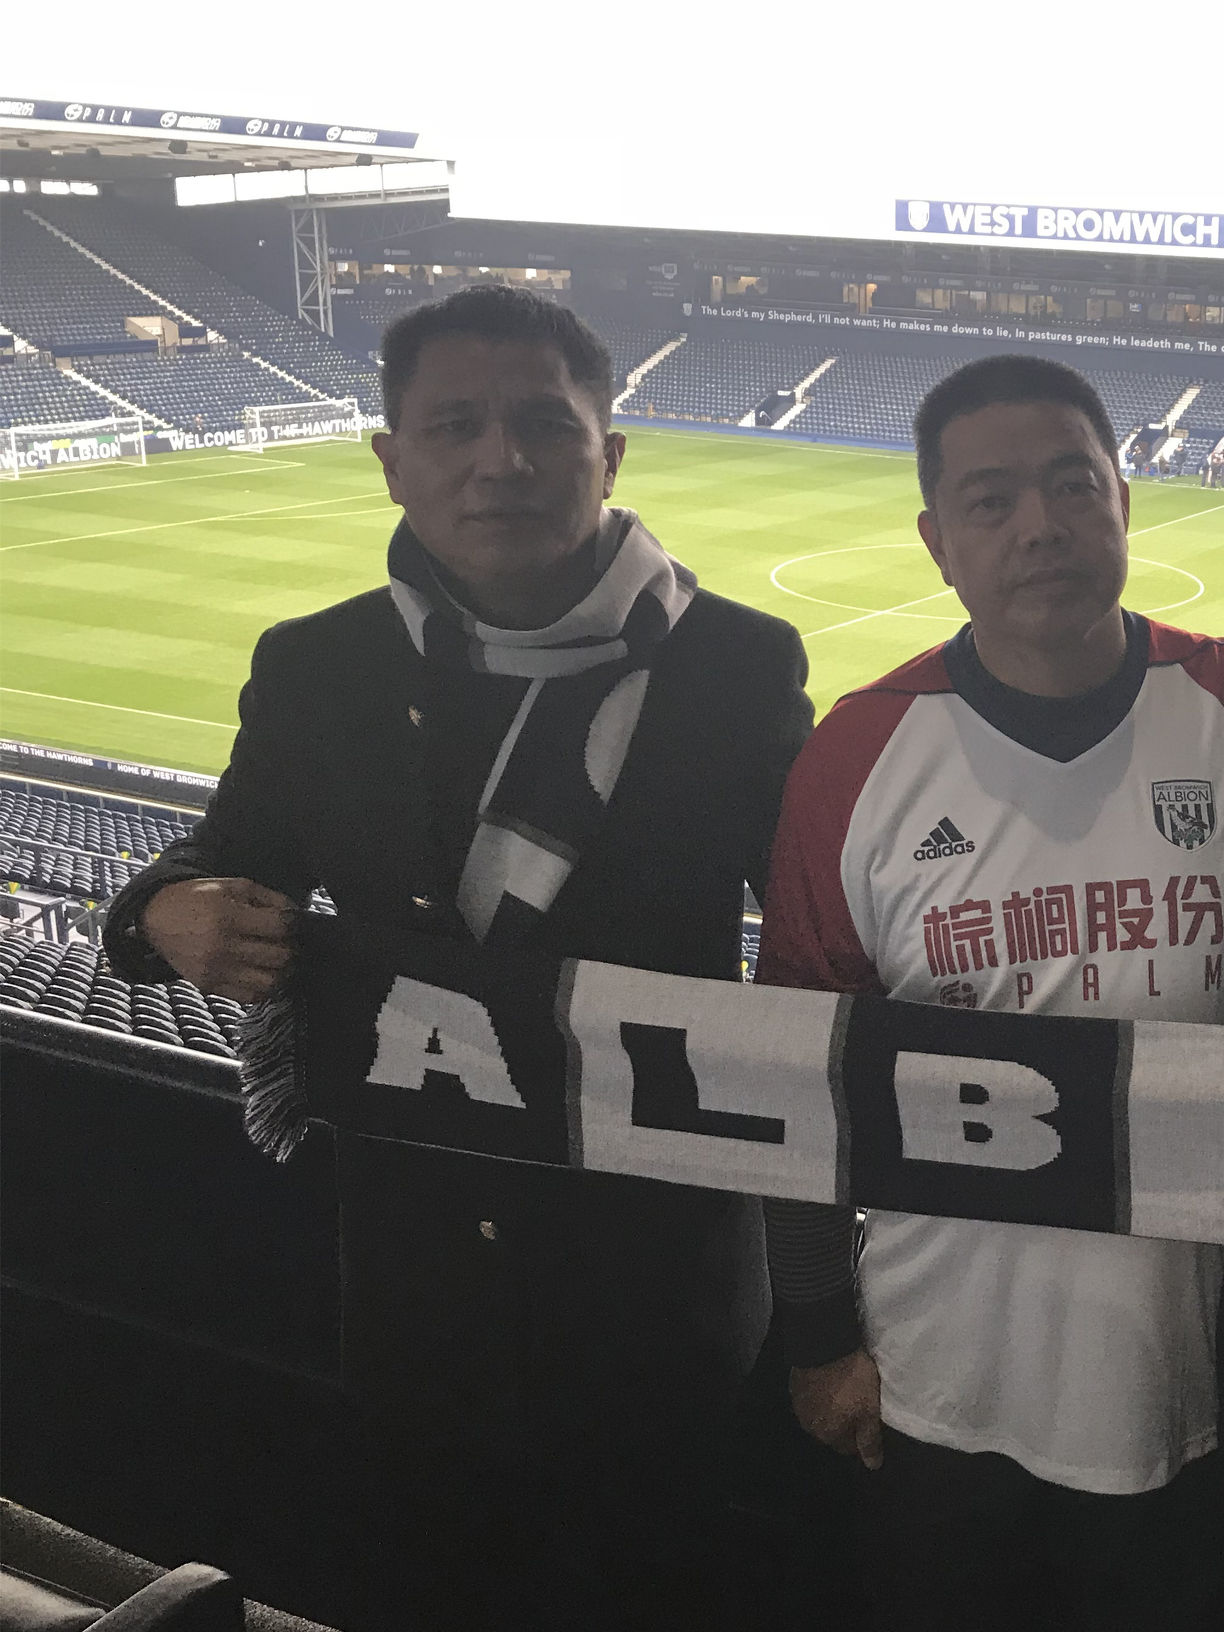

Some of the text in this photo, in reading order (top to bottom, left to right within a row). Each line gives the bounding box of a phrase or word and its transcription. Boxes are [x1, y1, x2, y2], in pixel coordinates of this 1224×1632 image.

[943, 203, 1028, 235] WEST
[1037, 208, 1220, 246] BROMWICH
[701, 305, 718, 316] The
[752, 311, 765, 321] my
[768, 310, 815, 325] Shepherd,
[834, 315, 850, 326] not
[853, 318, 880, 330] want;
[883, 319, 896, 330] He
[900, 320, 930, 332] makes
[934, 324, 948, 333] me
[952, 323, 979, 336] down
[982, 326, 993, 336] to
[996, 326, 1011, 339] lie,
[1015, 328, 1025, 339] In
[1029, 330, 1072, 343] pastures
[1076, 335, 1109, 346] green;
[1113, 335, 1127, 346] He
[1131, 336, 1170, 349] leadeth
[1175, 341, 1193, 352] me,
[1198, 341, 1216, 352] The
[169, 429, 245, 450] WELCOME
[57, 441, 121, 464] ALBION
[19, 744, 29, 755] TO
[31, 748, 45, 758] THE
[46, 750, 94, 767] HAWTHORNS
[117, 763, 140, 776] HOME
[141, 767, 151, 777] OF
[153, 770, 175, 781] WEST
[1157, 790, 1209, 803] ALBION
[913, 839, 976, 862] adidas
[923, 874, 1224, 979] 棕榈股份
[1017, 954, 1223, 1010] PALM
